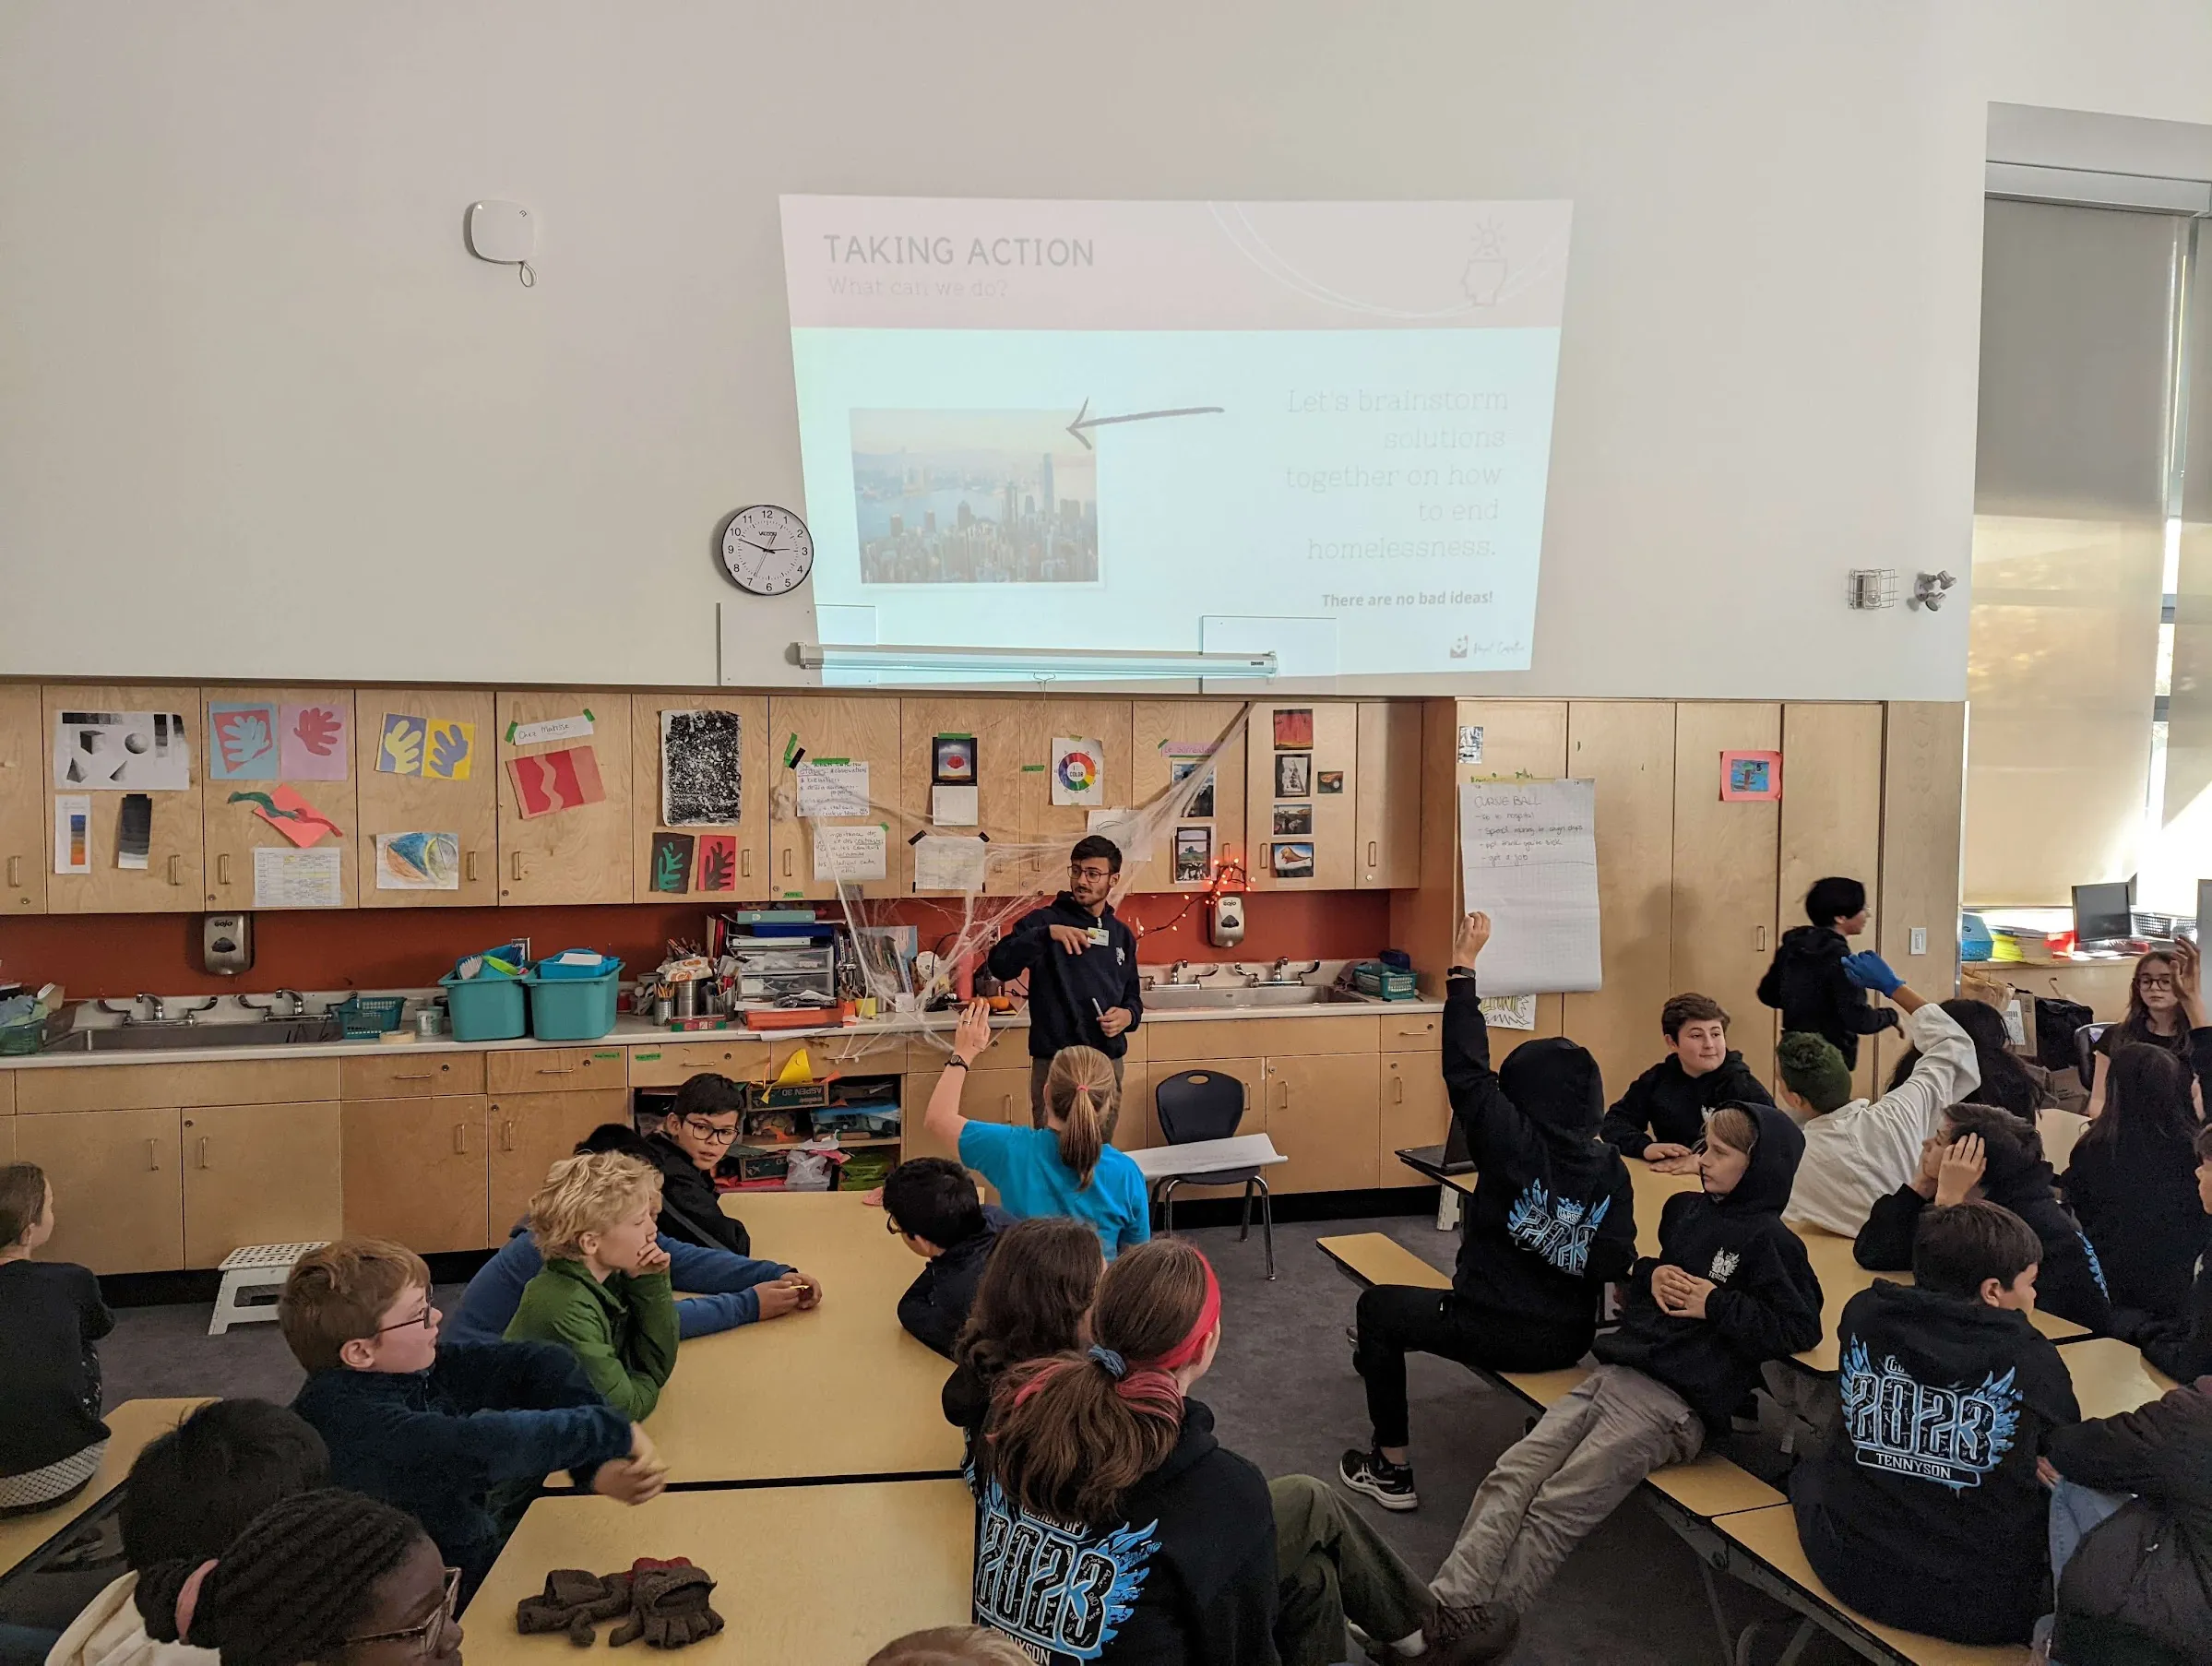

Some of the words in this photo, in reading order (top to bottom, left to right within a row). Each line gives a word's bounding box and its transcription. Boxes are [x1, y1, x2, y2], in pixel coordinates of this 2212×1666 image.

[824, 234, 954, 265] TAKING
[968, 237, 1094, 267] ACTION
[827, 275, 883, 296] What
[890, 280, 929, 296] can
[934, 280, 965, 296] we
[970, 278, 1007, 298] do?
[1286, 388, 1349, 413] Let's
[1358, 387, 1509, 412] brainstorm
[1384, 426, 1506, 449] solutions
[1286, 465, 1400, 494] together
[1407, 468, 1439, 487] on
[1448, 464, 1504, 487] how
[762, 510, 773, 519] 12
[1419, 499, 1444, 521] to
[1452, 498, 1499, 521] end
[743, 515, 753, 524] 11
[783, 516, 788, 524] 1
[730, 528, 742, 537] 10
[797, 530, 803, 538] 2
[727, 545, 734, 554] 9
[802, 547, 808, 556] 3
[1306, 537, 1497, 560] homelessness.
[733, 564, 740, 572] 8
[797, 565, 803, 574] 4
[747, 577, 753, 586] 7
[766, 583, 773, 591] 6
[785, 578, 791, 587] 5
[1322, 593, 1363, 607] There
[1368, 594, 1392, 607] are
[1396, 593, 1415, 606] no
[1419, 590, 1446, 606] bad
[1450, 589, 1493, 605] ideas!
[1474, 795, 1509, 808] CURVE
[1513, 795, 1541, 806] BALL
[1514, 854, 1528, 867] job
[794, 1087, 822, 1096] ASPEN
[1849, 1371, 1996, 1470] 2023
[1875, 1451, 1952, 1480] TENNYSON
[975, 1508, 1119, 1652] 2023
